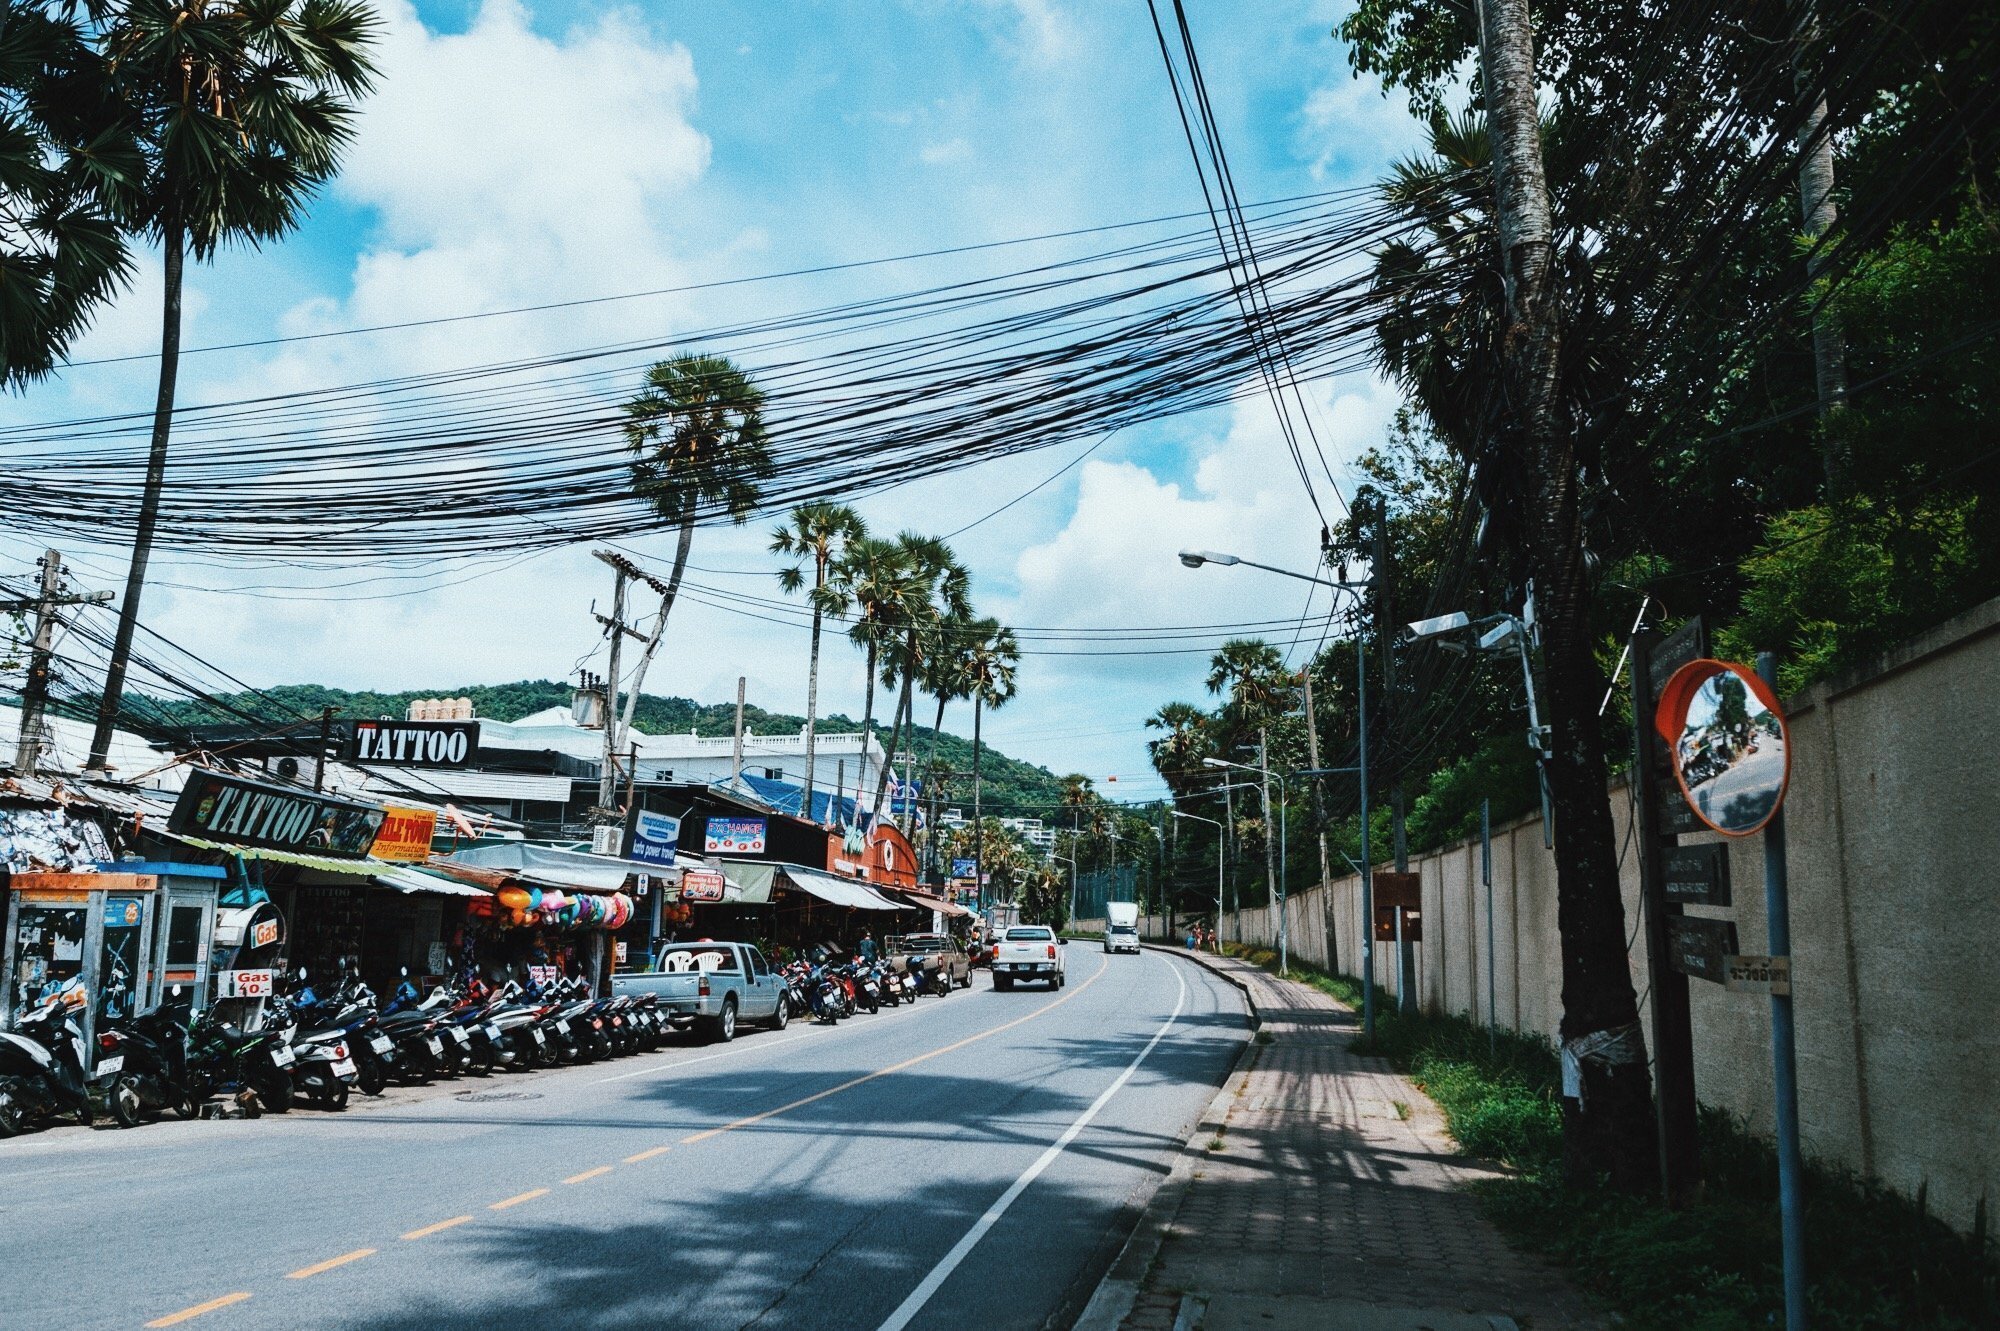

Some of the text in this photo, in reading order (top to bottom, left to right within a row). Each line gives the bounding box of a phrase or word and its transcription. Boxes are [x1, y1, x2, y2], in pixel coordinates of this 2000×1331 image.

[357, 727, 468, 763] TATTOO
[207, 786, 316, 844] TATTOO
[375, 842, 427, 855] Information
[643, 845, 661, 859] power
[660, 845, 677, 860] travel
[256, 924, 277, 945] Gas
[237, 972, 269, 983] Gas
